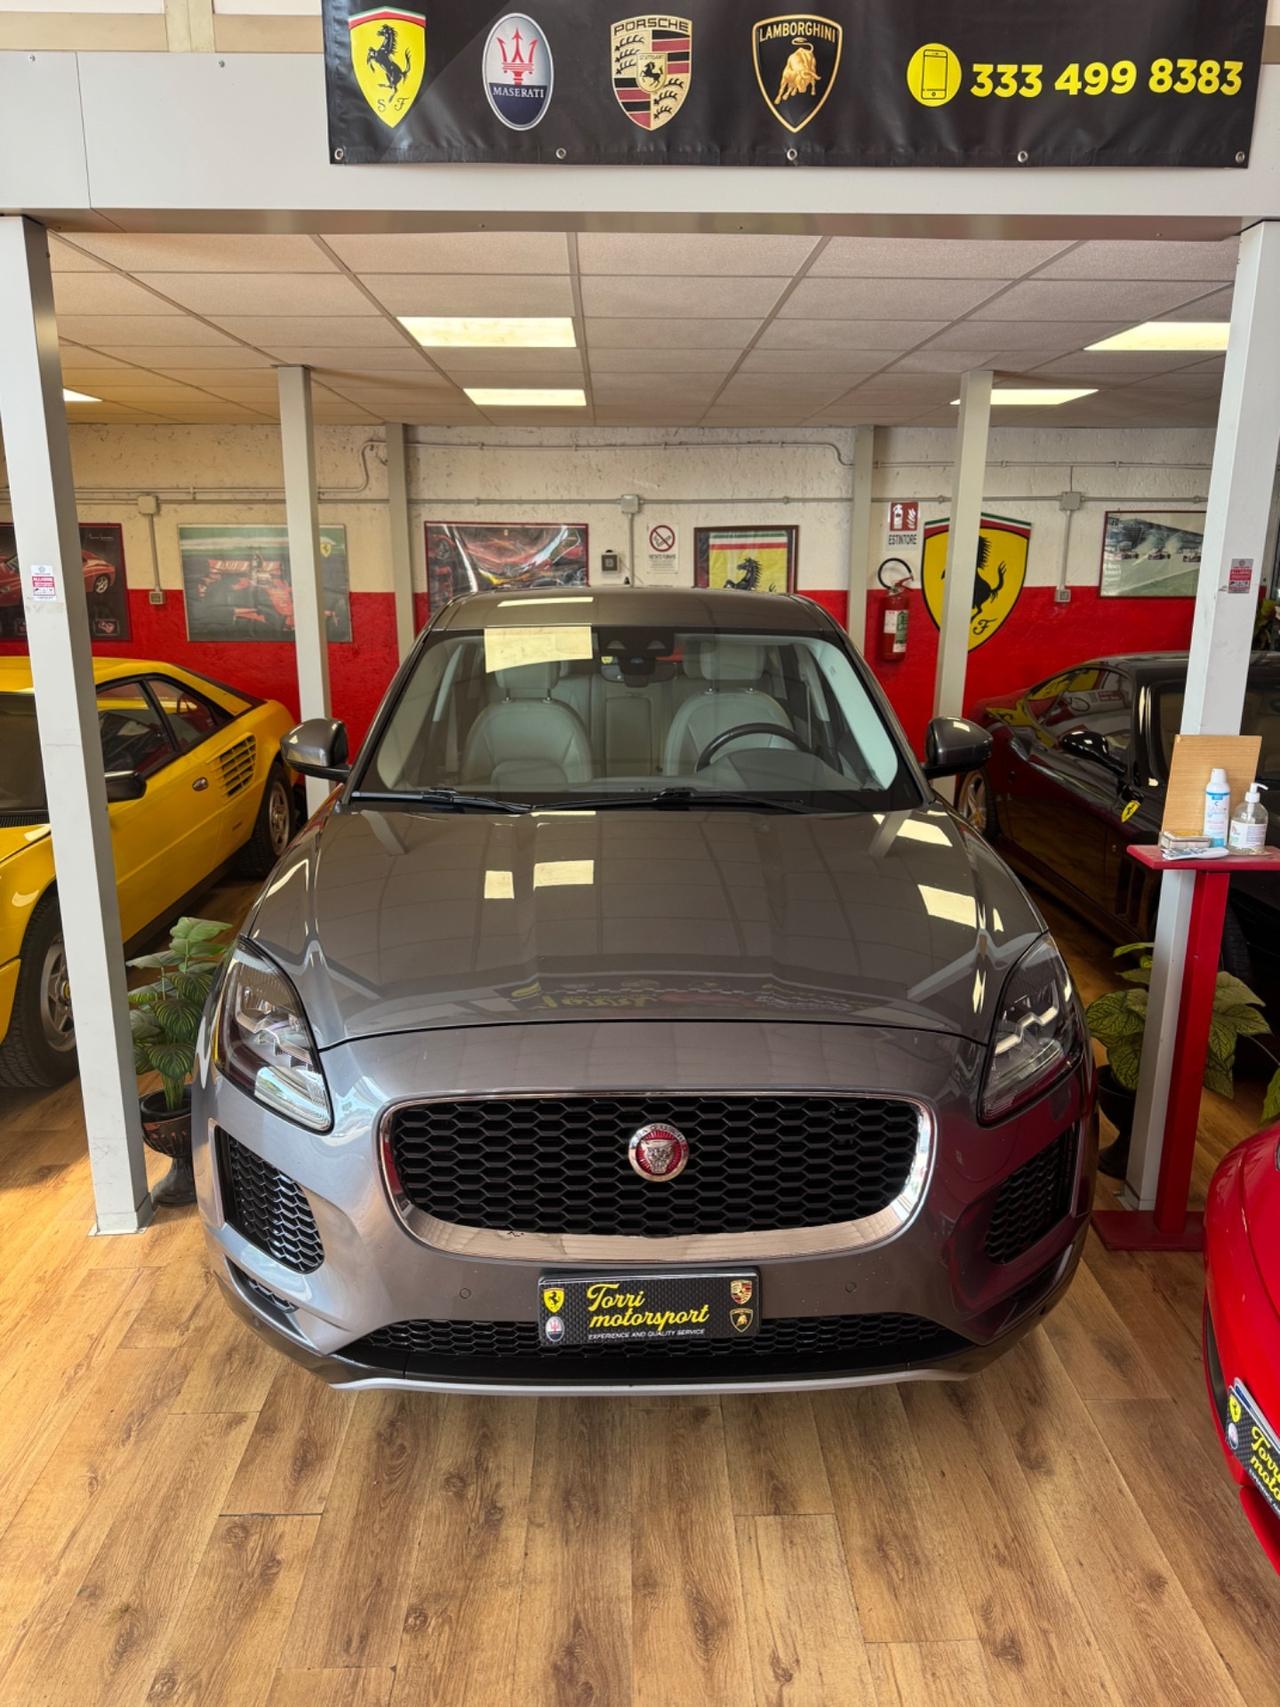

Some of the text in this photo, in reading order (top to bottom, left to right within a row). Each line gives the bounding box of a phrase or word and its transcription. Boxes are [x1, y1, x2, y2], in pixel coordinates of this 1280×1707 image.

[614, 18, 689, 35] PORSCHE
[759, 21, 836, 43] LAMBORGHINI
[970, 58, 1244, 98] 333 499 8383
[493, 86, 545, 98] MASERATI
[377, 98, 386, 112] S
[888, 534, 917, 545] ESTINTORE
[586, 1283, 645, 1312] Torri
[589, 1304, 710, 1332] motorsport
[588, 1331, 630, 1340] EXPERIENCE
[647, 1329, 676, 1337] QUALITY
[676, 1328, 705, 1336] SERVICE
[1251, 1426, 1280, 1482] Torr
